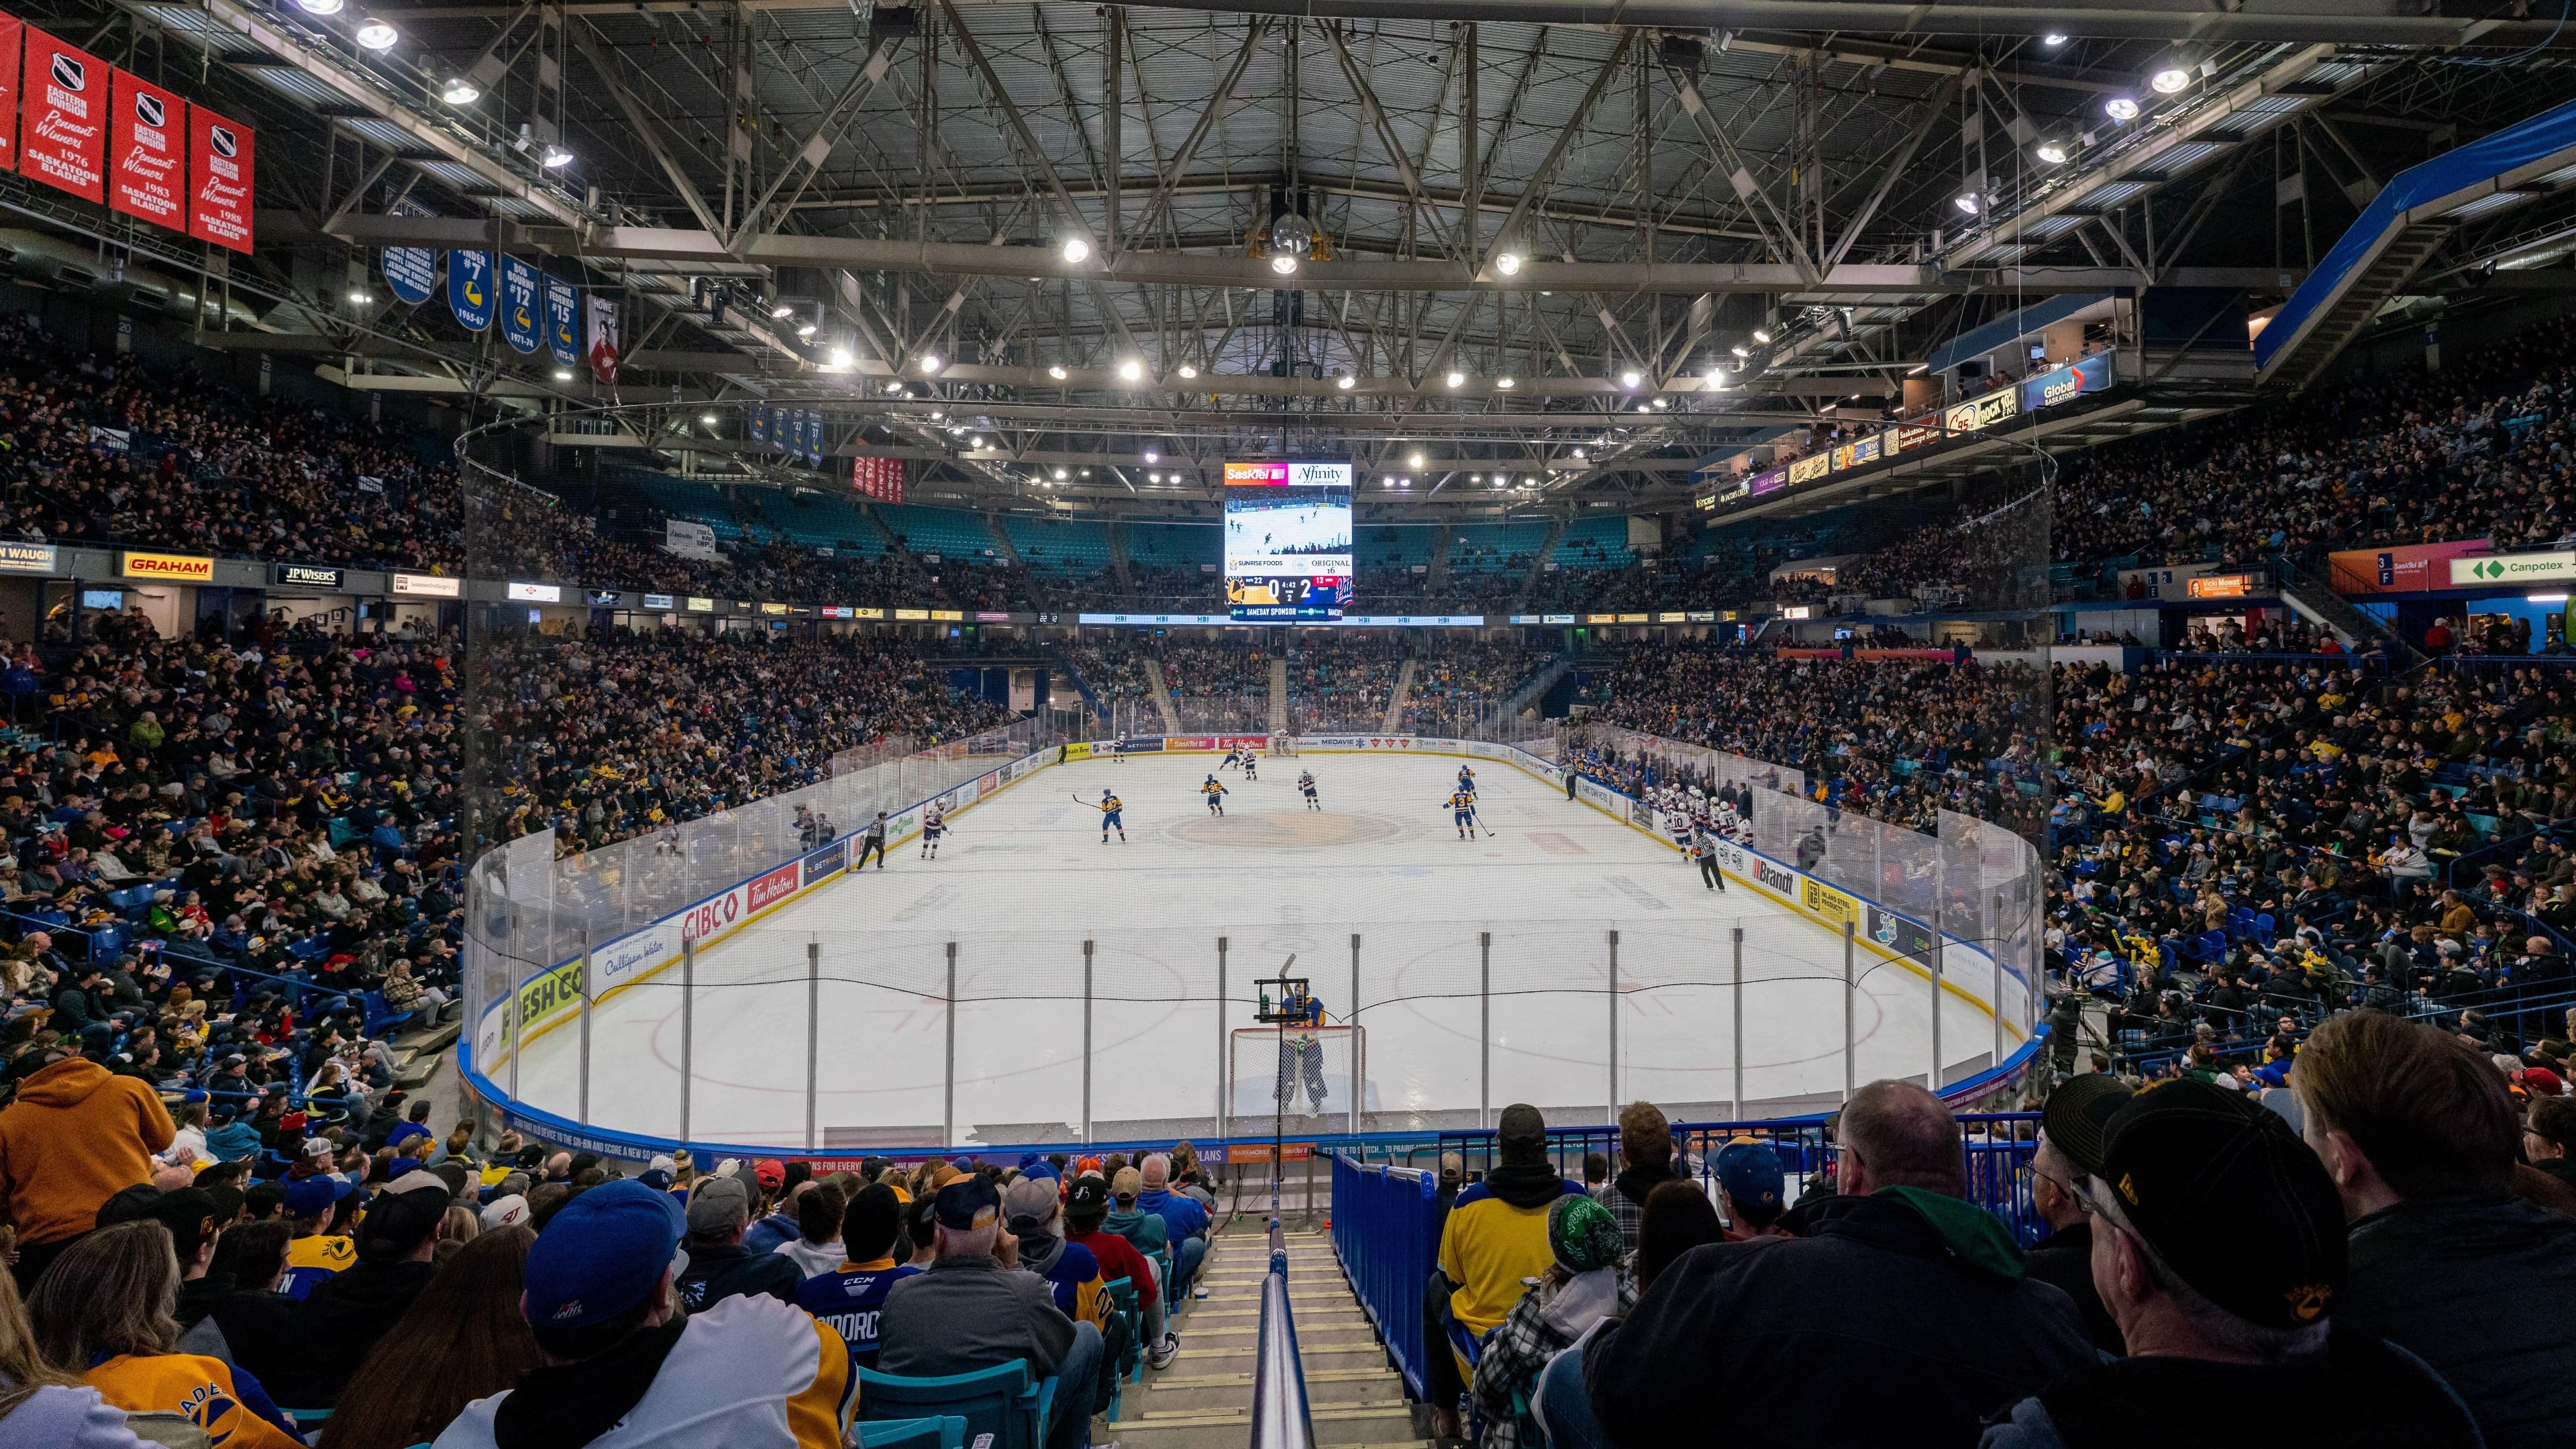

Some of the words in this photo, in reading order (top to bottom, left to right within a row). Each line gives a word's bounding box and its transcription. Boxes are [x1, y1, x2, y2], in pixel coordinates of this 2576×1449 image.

[47, 94, 87, 119] DIVISION
[48, 85, 87, 110] EASTERN
[45, 109, 98, 137] Pennant
[36, 121, 82, 148] Winners
[134, 123, 166, 142] EASTERN
[134, 132, 166, 152] DIVISION
[28, 149, 99, 183] SASKATOON
[60, 149, 88, 167] 1976
[131, 146, 177, 170] Pennant
[210, 155, 238, 172] EASTERN
[41, 162, 87, 187] BLADES
[123, 157, 164, 181] Winners
[210, 163, 239, 181] DIVISION
[145, 182, 170, 197] 1983
[208, 176, 247, 197] Pennant
[121, 185, 176, 211] SASKATOON
[130, 197, 167, 215] BLADES
[201, 187, 236, 208] Winners
[200, 213, 248, 235] SASKATOON
[220, 210, 242, 223] 1988
[208, 224, 239, 240] BLADES
[463, 258, 481, 280] #7
[514, 263, 527, 277] BOB
[507, 270, 534, 291] BOURNE
[509, 284, 531, 307] #12
[549, 290, 574, 309] FEDERKO
[552, 303, 570, 323] #15
[594, 299, 613, 313] HOWE
[459, 308, 484, 326] 1965-67
[511, 332, 533, 348] 1971-74
[2045, 380, 2075, 398] Global
[2045, 391, 2075, 406] SASKATOON
[1980, 401, 2000, 424] ROCK
[2000, 393, 2016, 410] 102
[2002, 405, 2015, 417] FM
[1900, 427, 1924, 439] Saskatoon
[1900, 435, 1926, 448] Landscape
[1926, 430, 1940, 440] Store
[1865, 442, 1879, 453] NEWS
[1227, 468, 1269, 480] SaskTel
[1298, 465, 1342, 483] Affinity
[1759, 478, 1769, 487] YOUR
[1696, 494, 1715, 509] koncept
[9, 548, 54, 560] WAUGH
[2379, 558, 2384, 568] 3
[131, 558, 209, 574] GRAHAM
[301, 568, 336, 581] WISER'S
[2393, 562, 2417, 570] SaskTel
[2510, 561, 2563, 572] Canpotex
[2163, 575, 2167, 583] 2
[2203, 579, 2218, 588] Vicki
[2218, 578, 2240, 586] Mowat
[2383, 572, 2389, 583] F
[1268, 579, 1279, 598] 0
[1300, 579, 1310, 598] 2
[2151, 588, 2155, 596] E
[1458, 797, 1465, 807] 3
[1674, 817, 1682, 828] 10
[1726, 817, 1735, 828] 13
[815, 850, 845, 872] BETRIVERS
[1759, 860, 1793, 895] Brandt
[751, 884, 769, 907] Tim
[770, 871, 794, 901] Hortons
[1821, 891, 1837, 902] INLAND
[1837, 898, 1850, 909] STEEL
[1821, 899, 1843, 914] PRODUCTS
[683, 899, 722, 940] CIBC
[605, 948, 643, 976] Culligan
[641, 942, 664, 958] Water
[502, 979, 555, 1041] FESH
[533, 1125, 541, 1135] OLD
[541, 1128, 556, 1140] DEVICE
[557, 1132, 563, 1142] TO
[563, 1134, 572, 1146] THE
[573, 1136, 592, 1150] SIN-BIN
[593, 1141, 603, 1151] AND
[604, 1144, 622, 1155] SCORE
[623, 1147, 627, 1156] A
[628, 1148, 641, 1158] NEW
[1323, 1146, 1333, 1154] IT'S
[823, 1162, 835, 1170] FOR
[894, 1163, 907, 1171] SAVE
[843, 1277, 876, 1285] CCM
